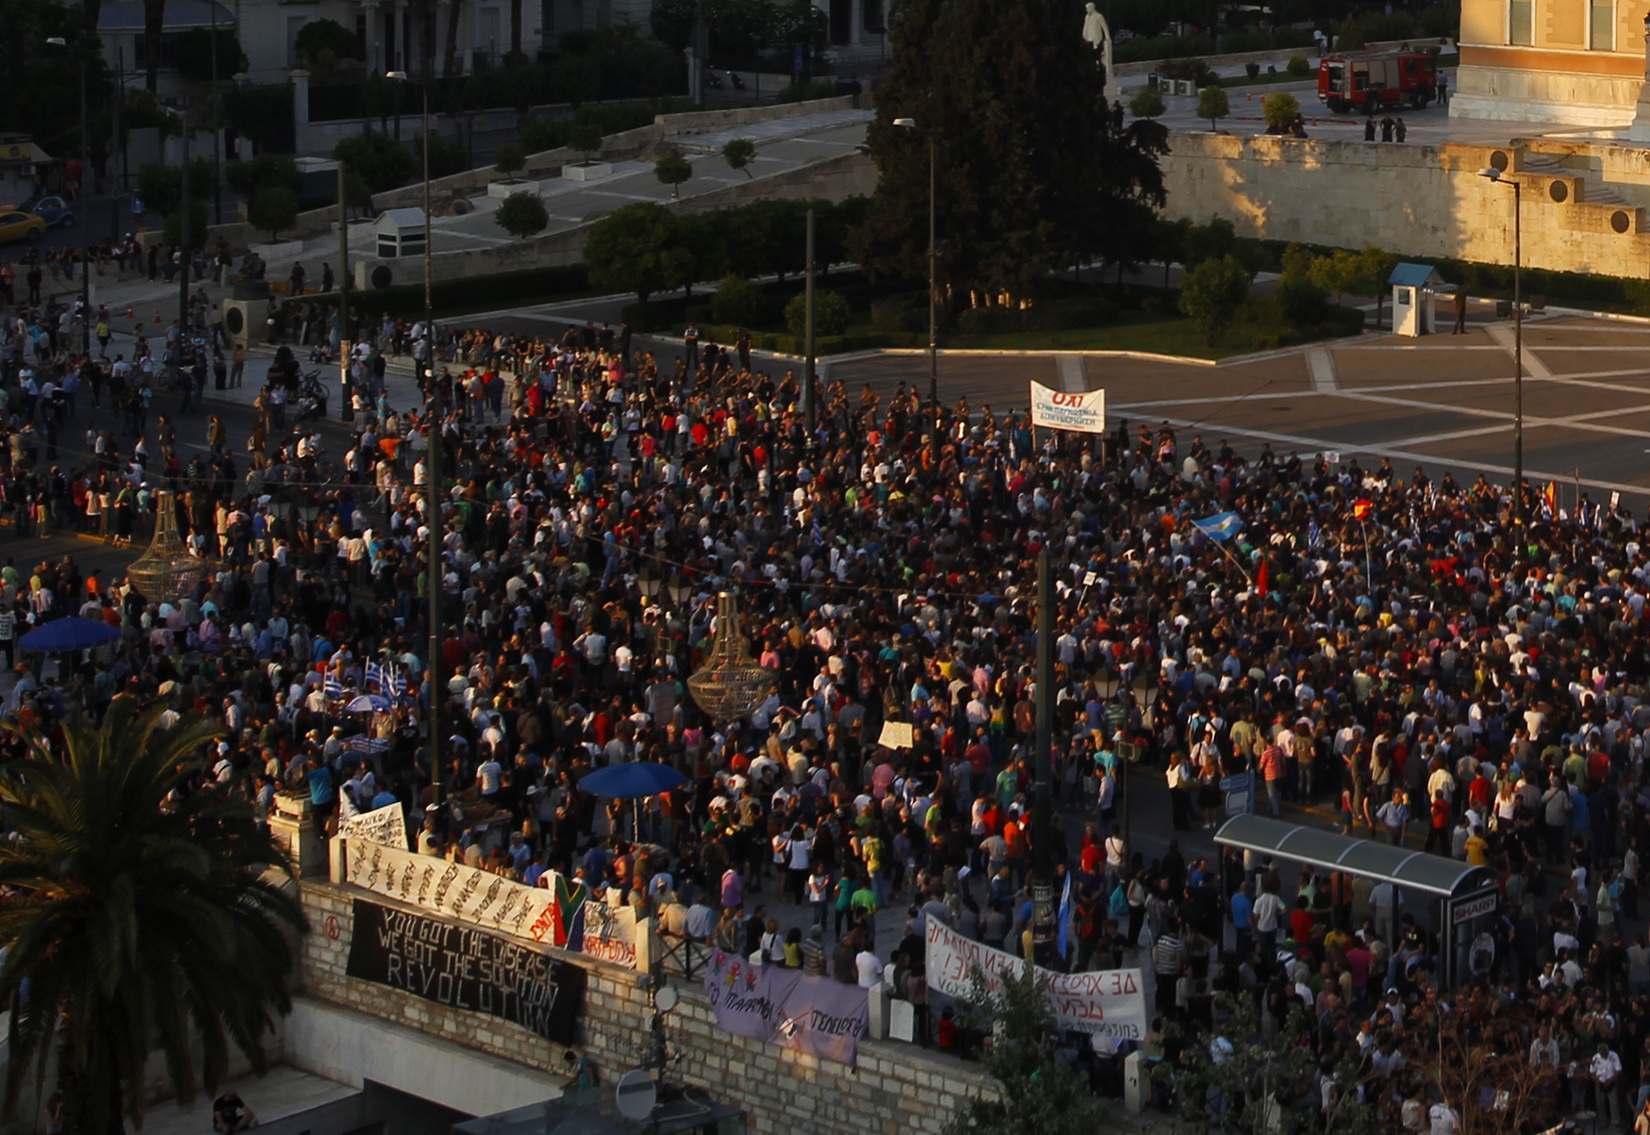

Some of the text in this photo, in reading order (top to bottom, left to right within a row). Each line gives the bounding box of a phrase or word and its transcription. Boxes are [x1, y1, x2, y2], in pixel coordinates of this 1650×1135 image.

[378, 926, 401, 952] WE
[403, 937, 438, 968] GOT
[441, 950, 475, 980] THE
[381, 907, 415, 937] YOU
[419, 921, 455, 945] GOT
[458, 926, 490, 959] THE
[493, 938, 560, 981] DISEASE
